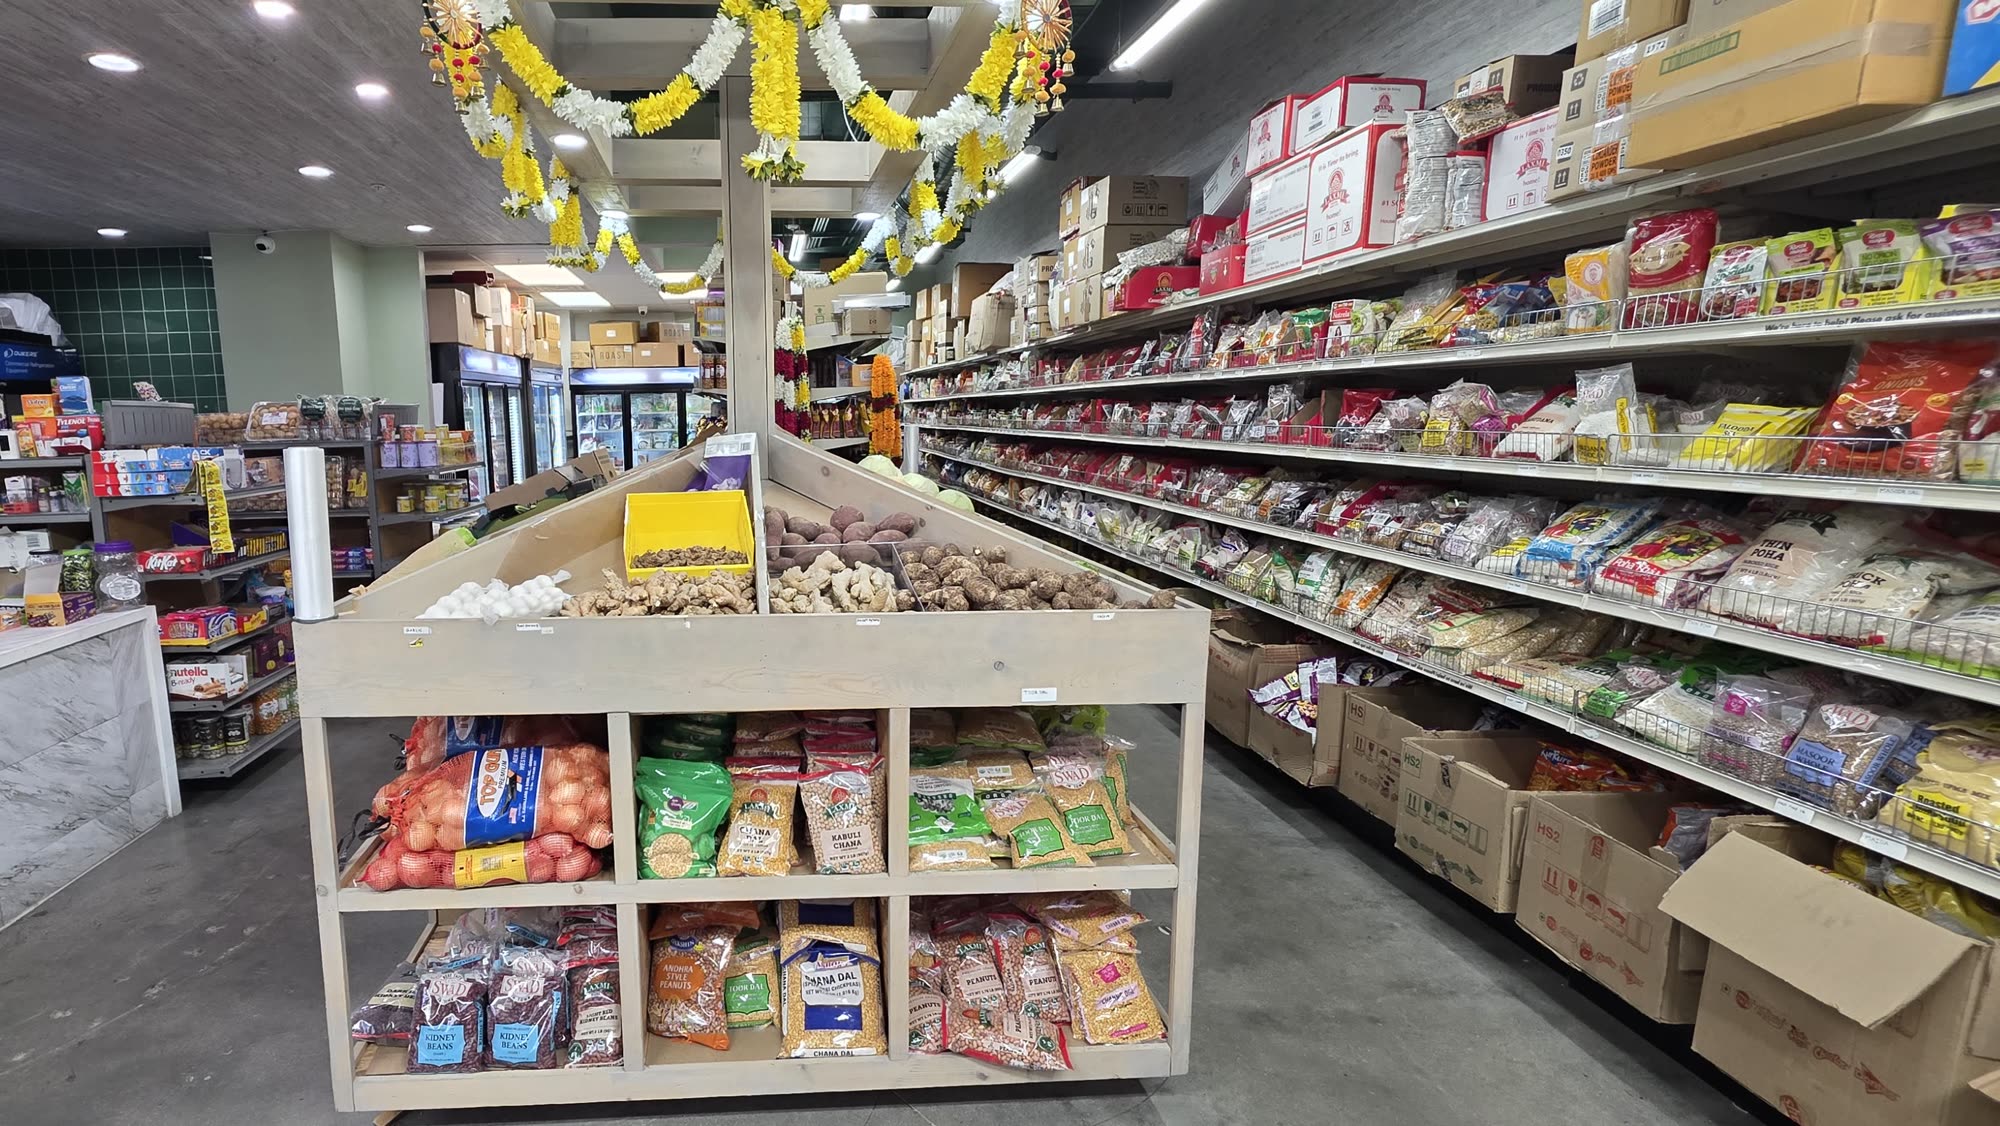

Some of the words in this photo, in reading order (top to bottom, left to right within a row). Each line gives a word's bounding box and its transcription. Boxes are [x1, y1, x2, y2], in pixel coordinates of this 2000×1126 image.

[1521, 159, 1546, 171] LAXMI
[1764, 323, 1790, 332] We're
[1824, 318, 1848, 328] help!
[1850, 314, 1882, 325] Please
[1885, 312, 1904, 322] ask
[1905, 310, 1922, 320] for
[1924, 307, 1983, 319] assistance
[1873, 376, 1928, 391] ONIONS
[57, 418, 86, 426] TYLENOL
[1760, 539, 1793, 551] THIN
[1751, 548, 1785, 562] POHA
[1613, 558, 1635, 570] Poha
[1847, 571, 1887, 586] ICK
[168, 666, 209, 678] nutella
[170, 677, 196, 686] B-ready
[1350, 703, 1364, 718] HS
[1826, 703, 1871, 726] WAD
[1404, 750, 1421, 770] HS2
[497, 760, 507, 790] PREMIUM
[1054, 767, 1090, 784] SWAD
[479, 774, 497, 806] TOP
[994, 798, 1029, 817] SWAD
[1917, 794, 1960, 814] Roasted
[831, 831, 861, 842] KABULI
[1537, 820, 1562, 845] HS2
[833, 840, 862, 849] CHANA
[959, 943, 982, 954] LAXMI
[1024, 942, 1046, 953] LAXM
[662, 964, 693, 973] ANDHRA
[666, 973, 688, 981] STYLE
[837, 971, 857, 982] DAL
[965, 976, 998, 986] PEANUTS
[585, 983, 611, 994] LAXMI
[660, 980, 692, 990] PEANUTS
[729, 985, 748, 993] TOOR
[909, 1002, 942, 1014] PEANUTS
[579, 1017, 599, 1025] KIDNEY
[425, 1033, 457, 1042] KIDNEY
[499, 1032, 529, 1041] KIDNEY
[426, 1042, 454, 1051] BEANS
[501, 1041, 528, 1050] BEANS
